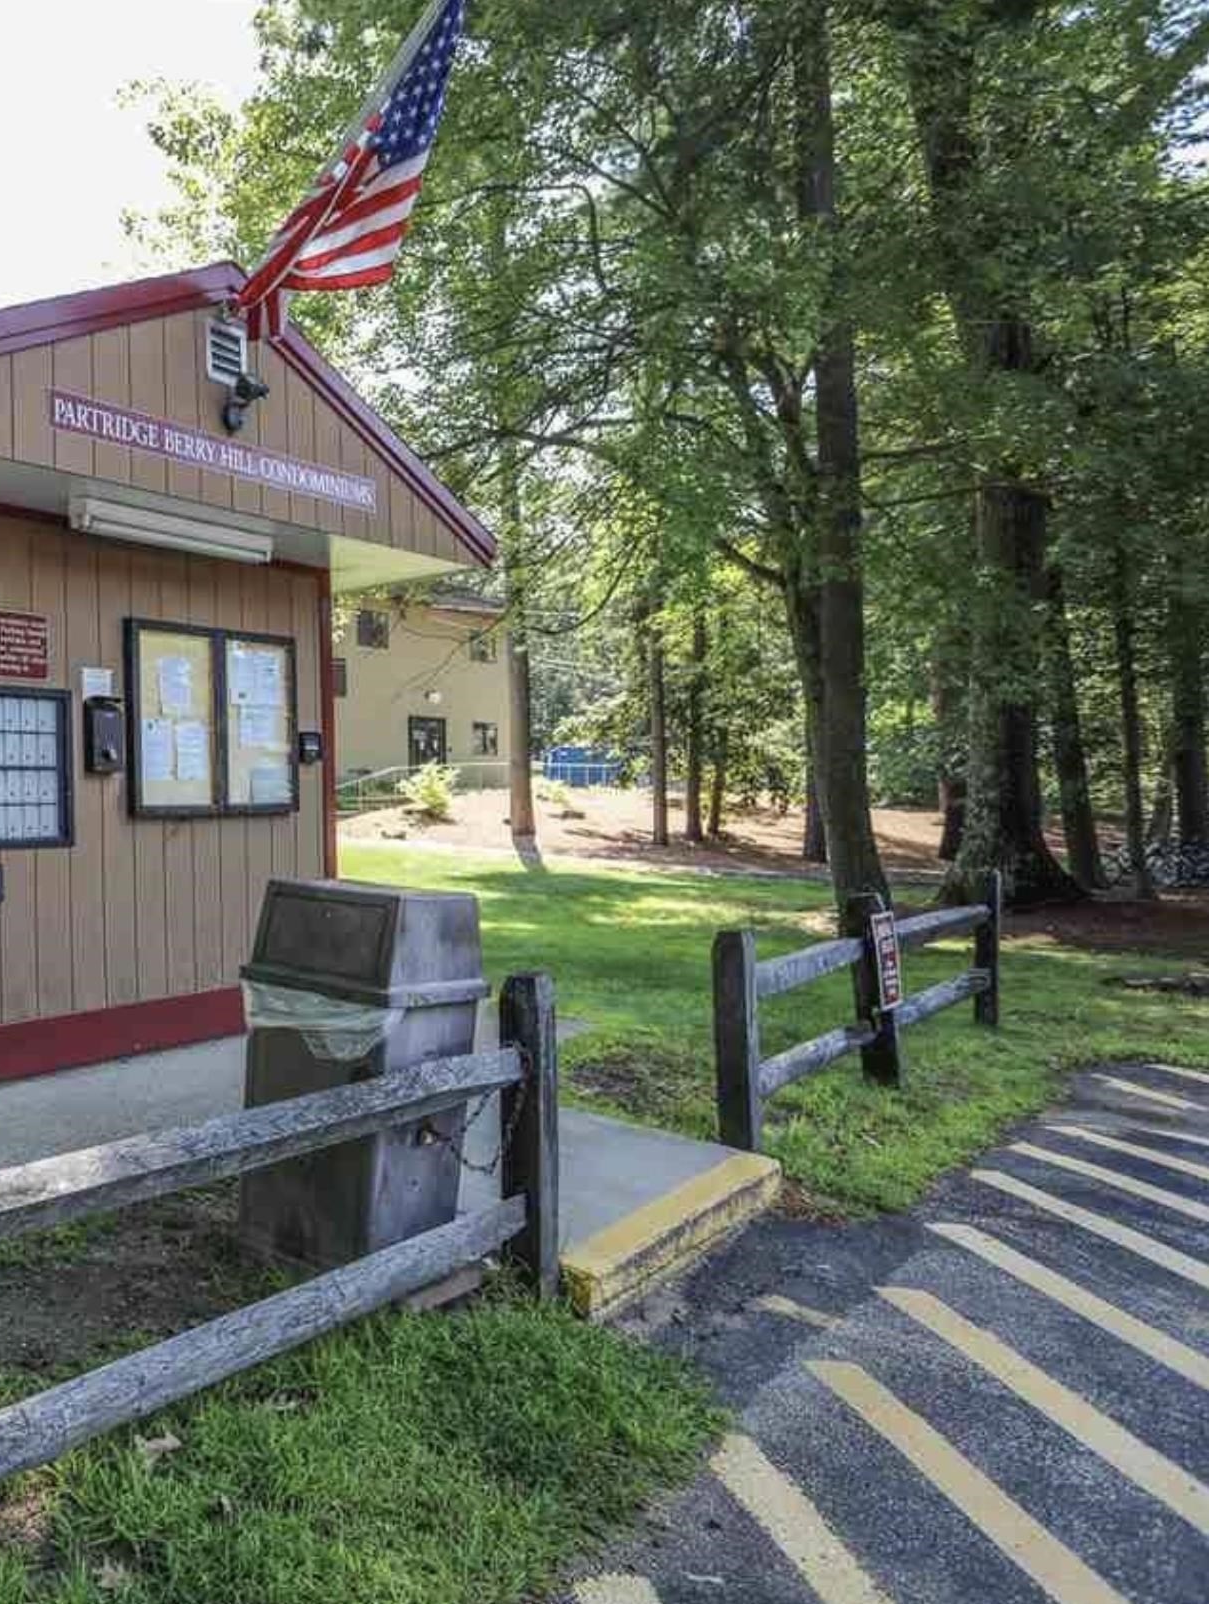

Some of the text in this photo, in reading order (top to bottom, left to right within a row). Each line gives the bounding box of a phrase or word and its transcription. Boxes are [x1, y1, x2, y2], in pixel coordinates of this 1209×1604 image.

[54, 398, 160, 447] PARTRIDGE
[163, 428, 217, 463] BERRY
[220, 443, 257, 476] HILL
